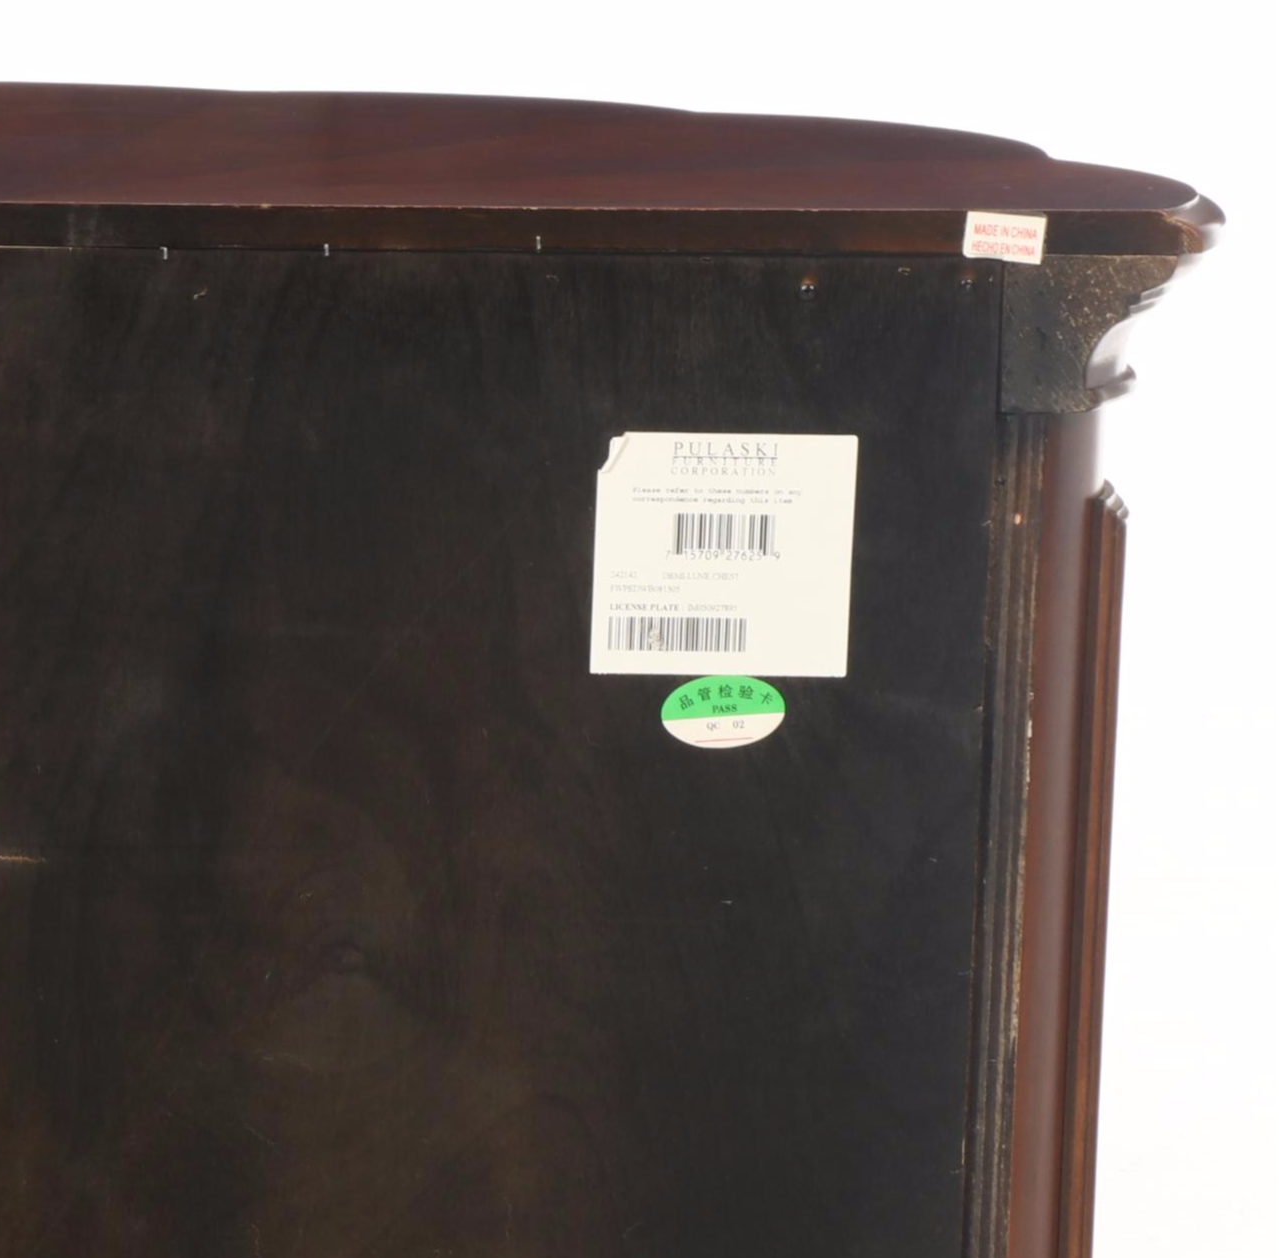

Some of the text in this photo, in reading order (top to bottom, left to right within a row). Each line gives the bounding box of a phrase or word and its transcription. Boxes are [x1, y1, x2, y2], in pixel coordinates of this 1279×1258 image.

[974, 223, 1038, 239] MADE IN CHINA
[971, 241, 1036, 256] HECHO EN CHINA
[673, 441, 779, 456] PULASKI
[672, 457, 778, 466] FURNITURE
[670, 466, 776, 476] CORPORATION
[632, 486, 661, 494] Please
[665, 486, 689, 494] refer
[788, 489, 802, 497] any
[703, 496, 745, 504] regarding
[684, 550, 719, 560] 15709
[726, 550, 762, 561] 27625
[774, 550, 781, 560] 9
[712, 572, 739, 581] CHEST
[609, 603, 648, 611] LICENSE
[650, 603, 680, 611] PLATE
[679, 684, 773, 711] 品管检验卡
[712, 704, 738, 713] PASS
[706, 721, 745, 731] QC 02
